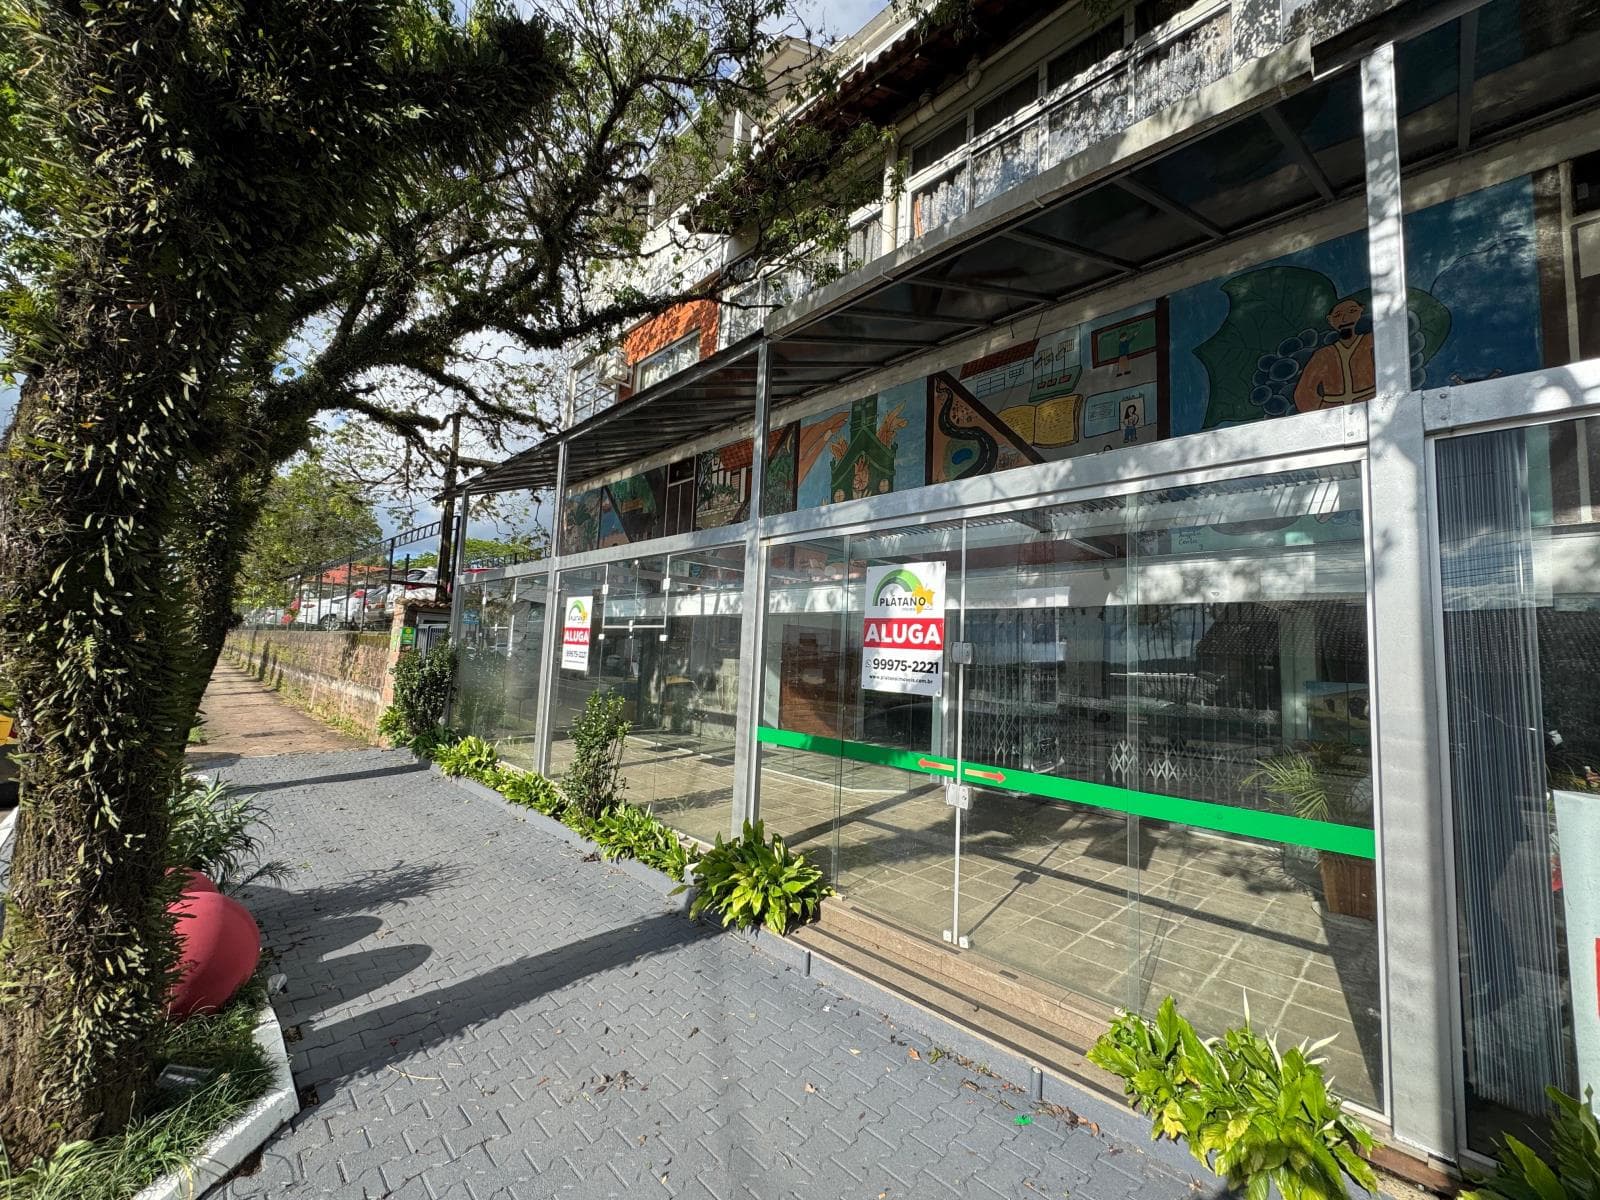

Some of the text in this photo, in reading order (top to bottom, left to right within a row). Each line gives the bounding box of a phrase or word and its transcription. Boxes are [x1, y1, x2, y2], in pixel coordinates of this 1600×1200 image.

[564, 631, 589, 641] ALUGA
[865, 624, 941, 645] ALUGA
[873, 658, 939, 674] 99975-2221
